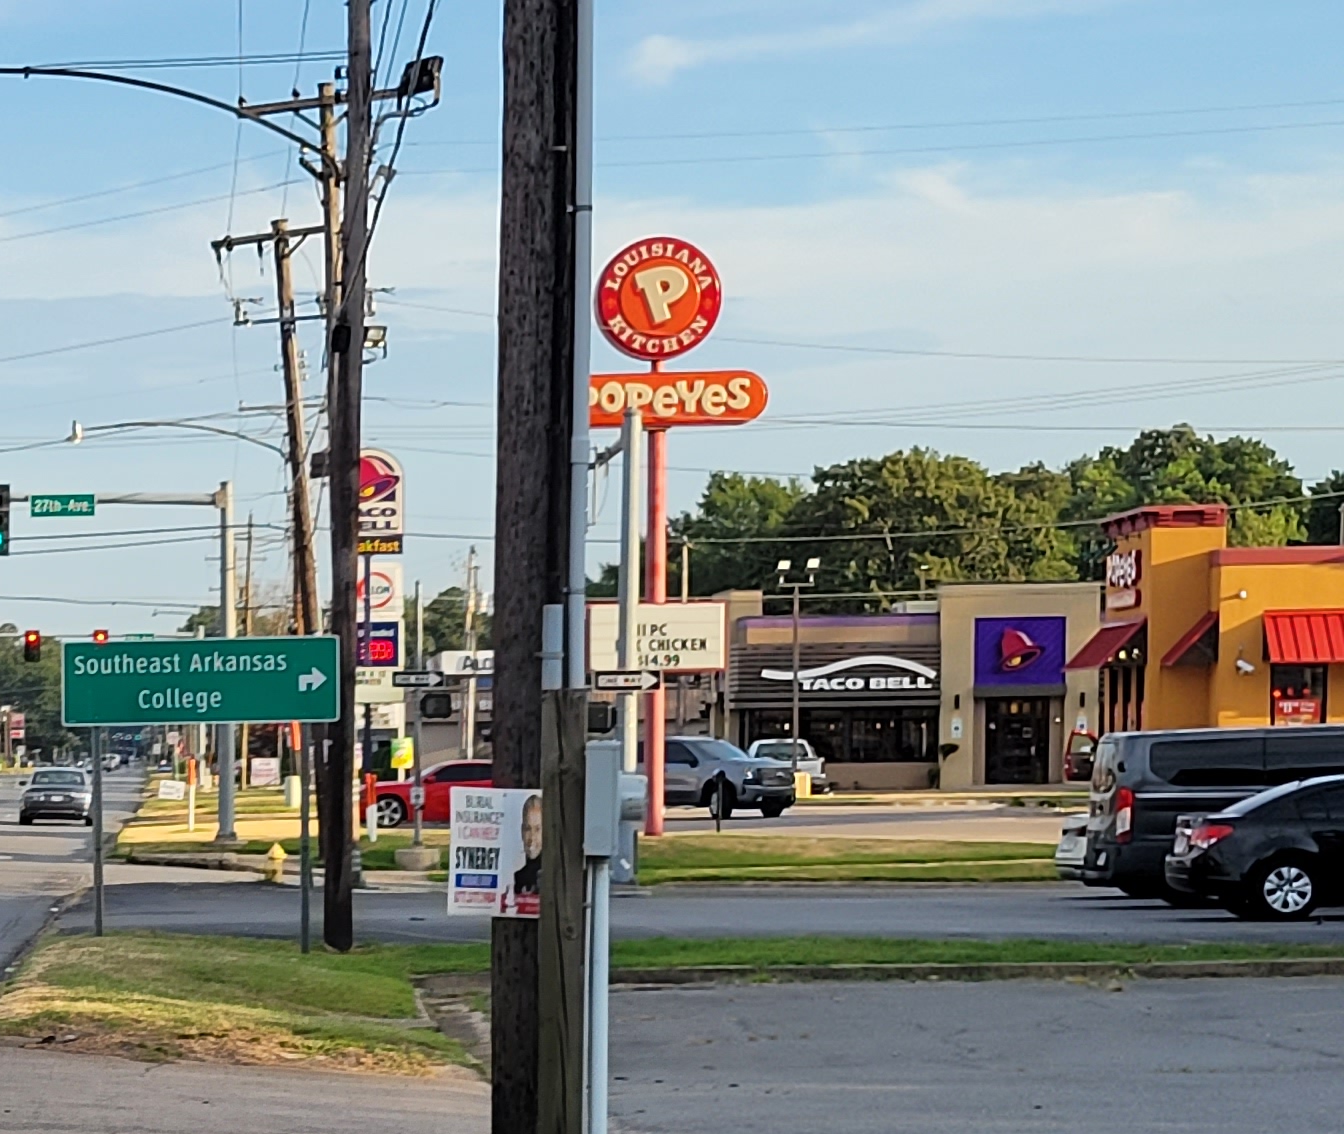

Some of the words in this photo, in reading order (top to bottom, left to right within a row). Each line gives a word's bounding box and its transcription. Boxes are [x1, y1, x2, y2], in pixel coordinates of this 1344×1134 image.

[605, 243, 712, 291] LOUISIANA
[608, 314, 708, 354] KITCHEN
[359, 507, 397, 518] ACO
[359, 520, 399, 532] ELL
[358, 539, 400, 552] akfast
[650, 623, 668, 636] PC
[648, 638, 707, 651] CHICKEN
[74, 653, 181, 675] Southeast
[189, 651, 287, 673] Arkansas
[637, 655, 680, 667] $14.99
[799, 678, 865, 691] TACO
[869, 676, 933, 689] BELL
[138, 688, 222, 713] College
[455, 846, 501, 870] SYNERGY
